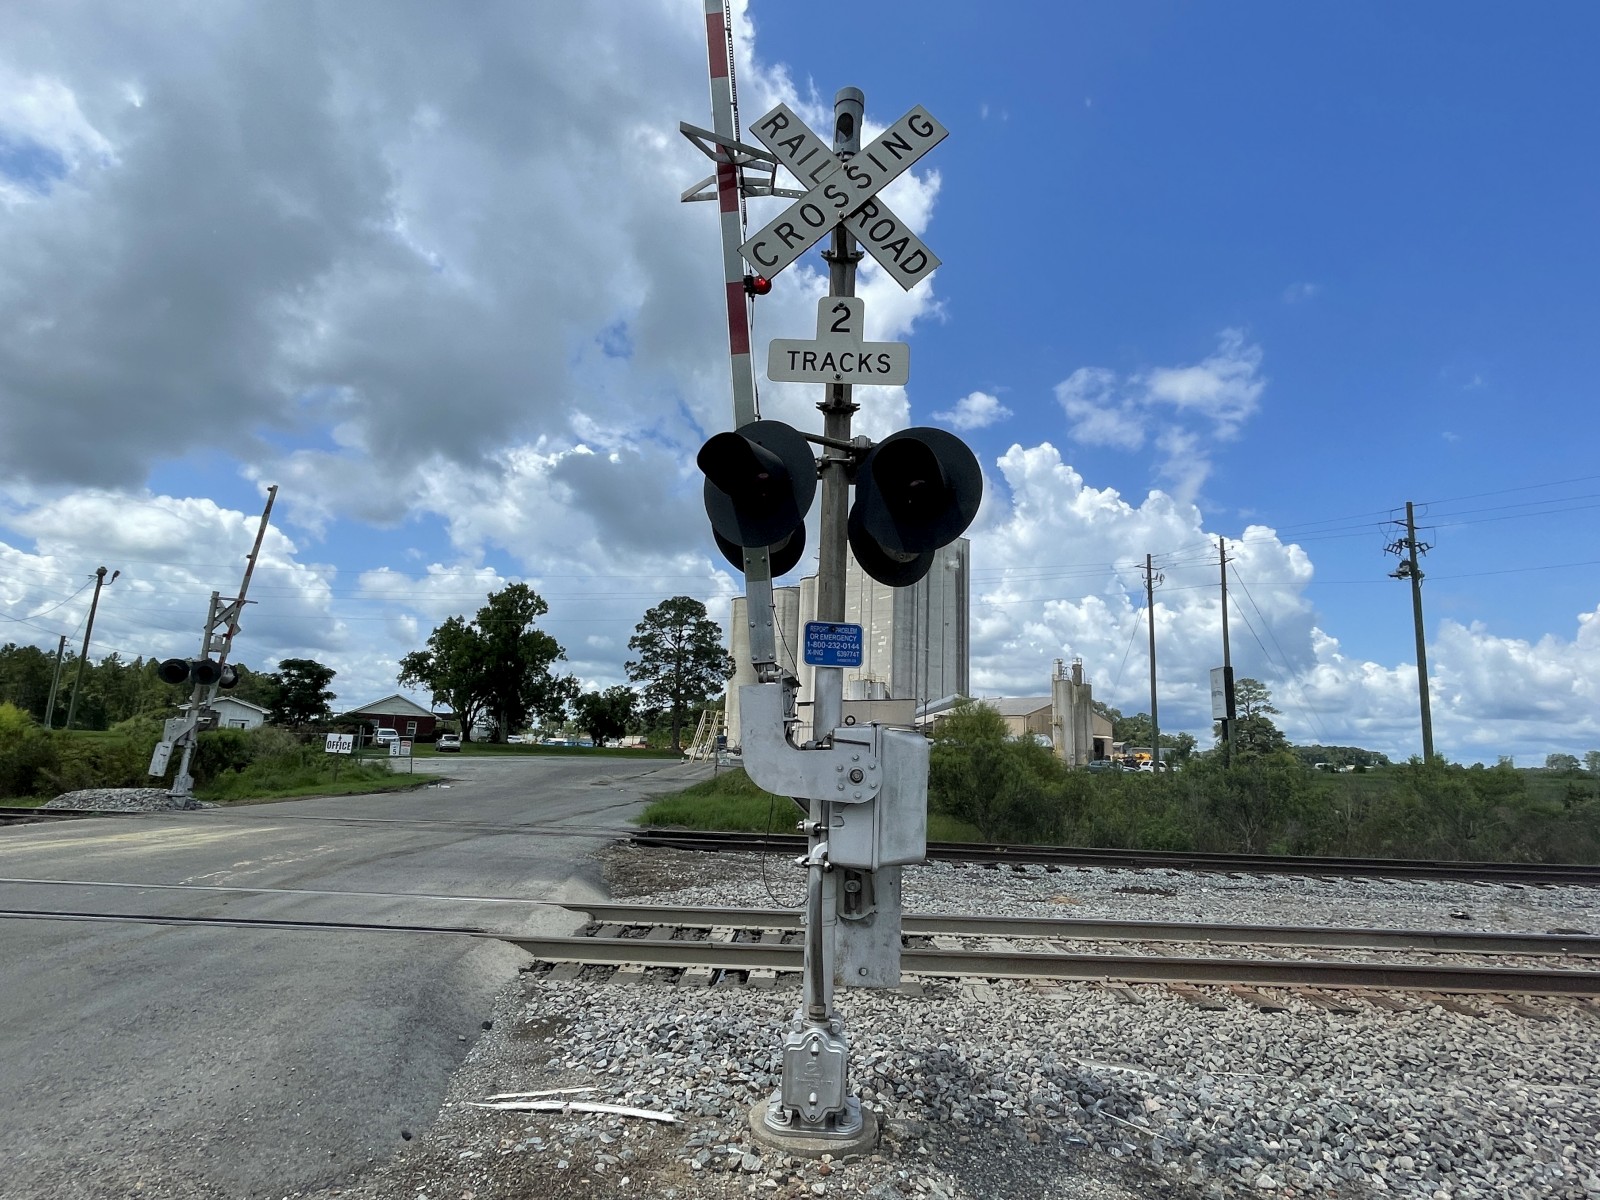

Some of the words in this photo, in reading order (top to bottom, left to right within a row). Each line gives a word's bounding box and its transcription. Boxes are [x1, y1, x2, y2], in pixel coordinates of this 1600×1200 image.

[761, 112, 831, 184] RAIL
[752, 114, 934, 267] CROSSING
[850, 200, 928, 275] ROAD
[830, 305, 851, 333] 2
[787, 351, 891, 374] TRACKS
[808, 641, 860, 650] 1-800-232-0144
[820, 634, 856, 642] EMERGENCY
[326, 740, 352, 750] OFFICE
